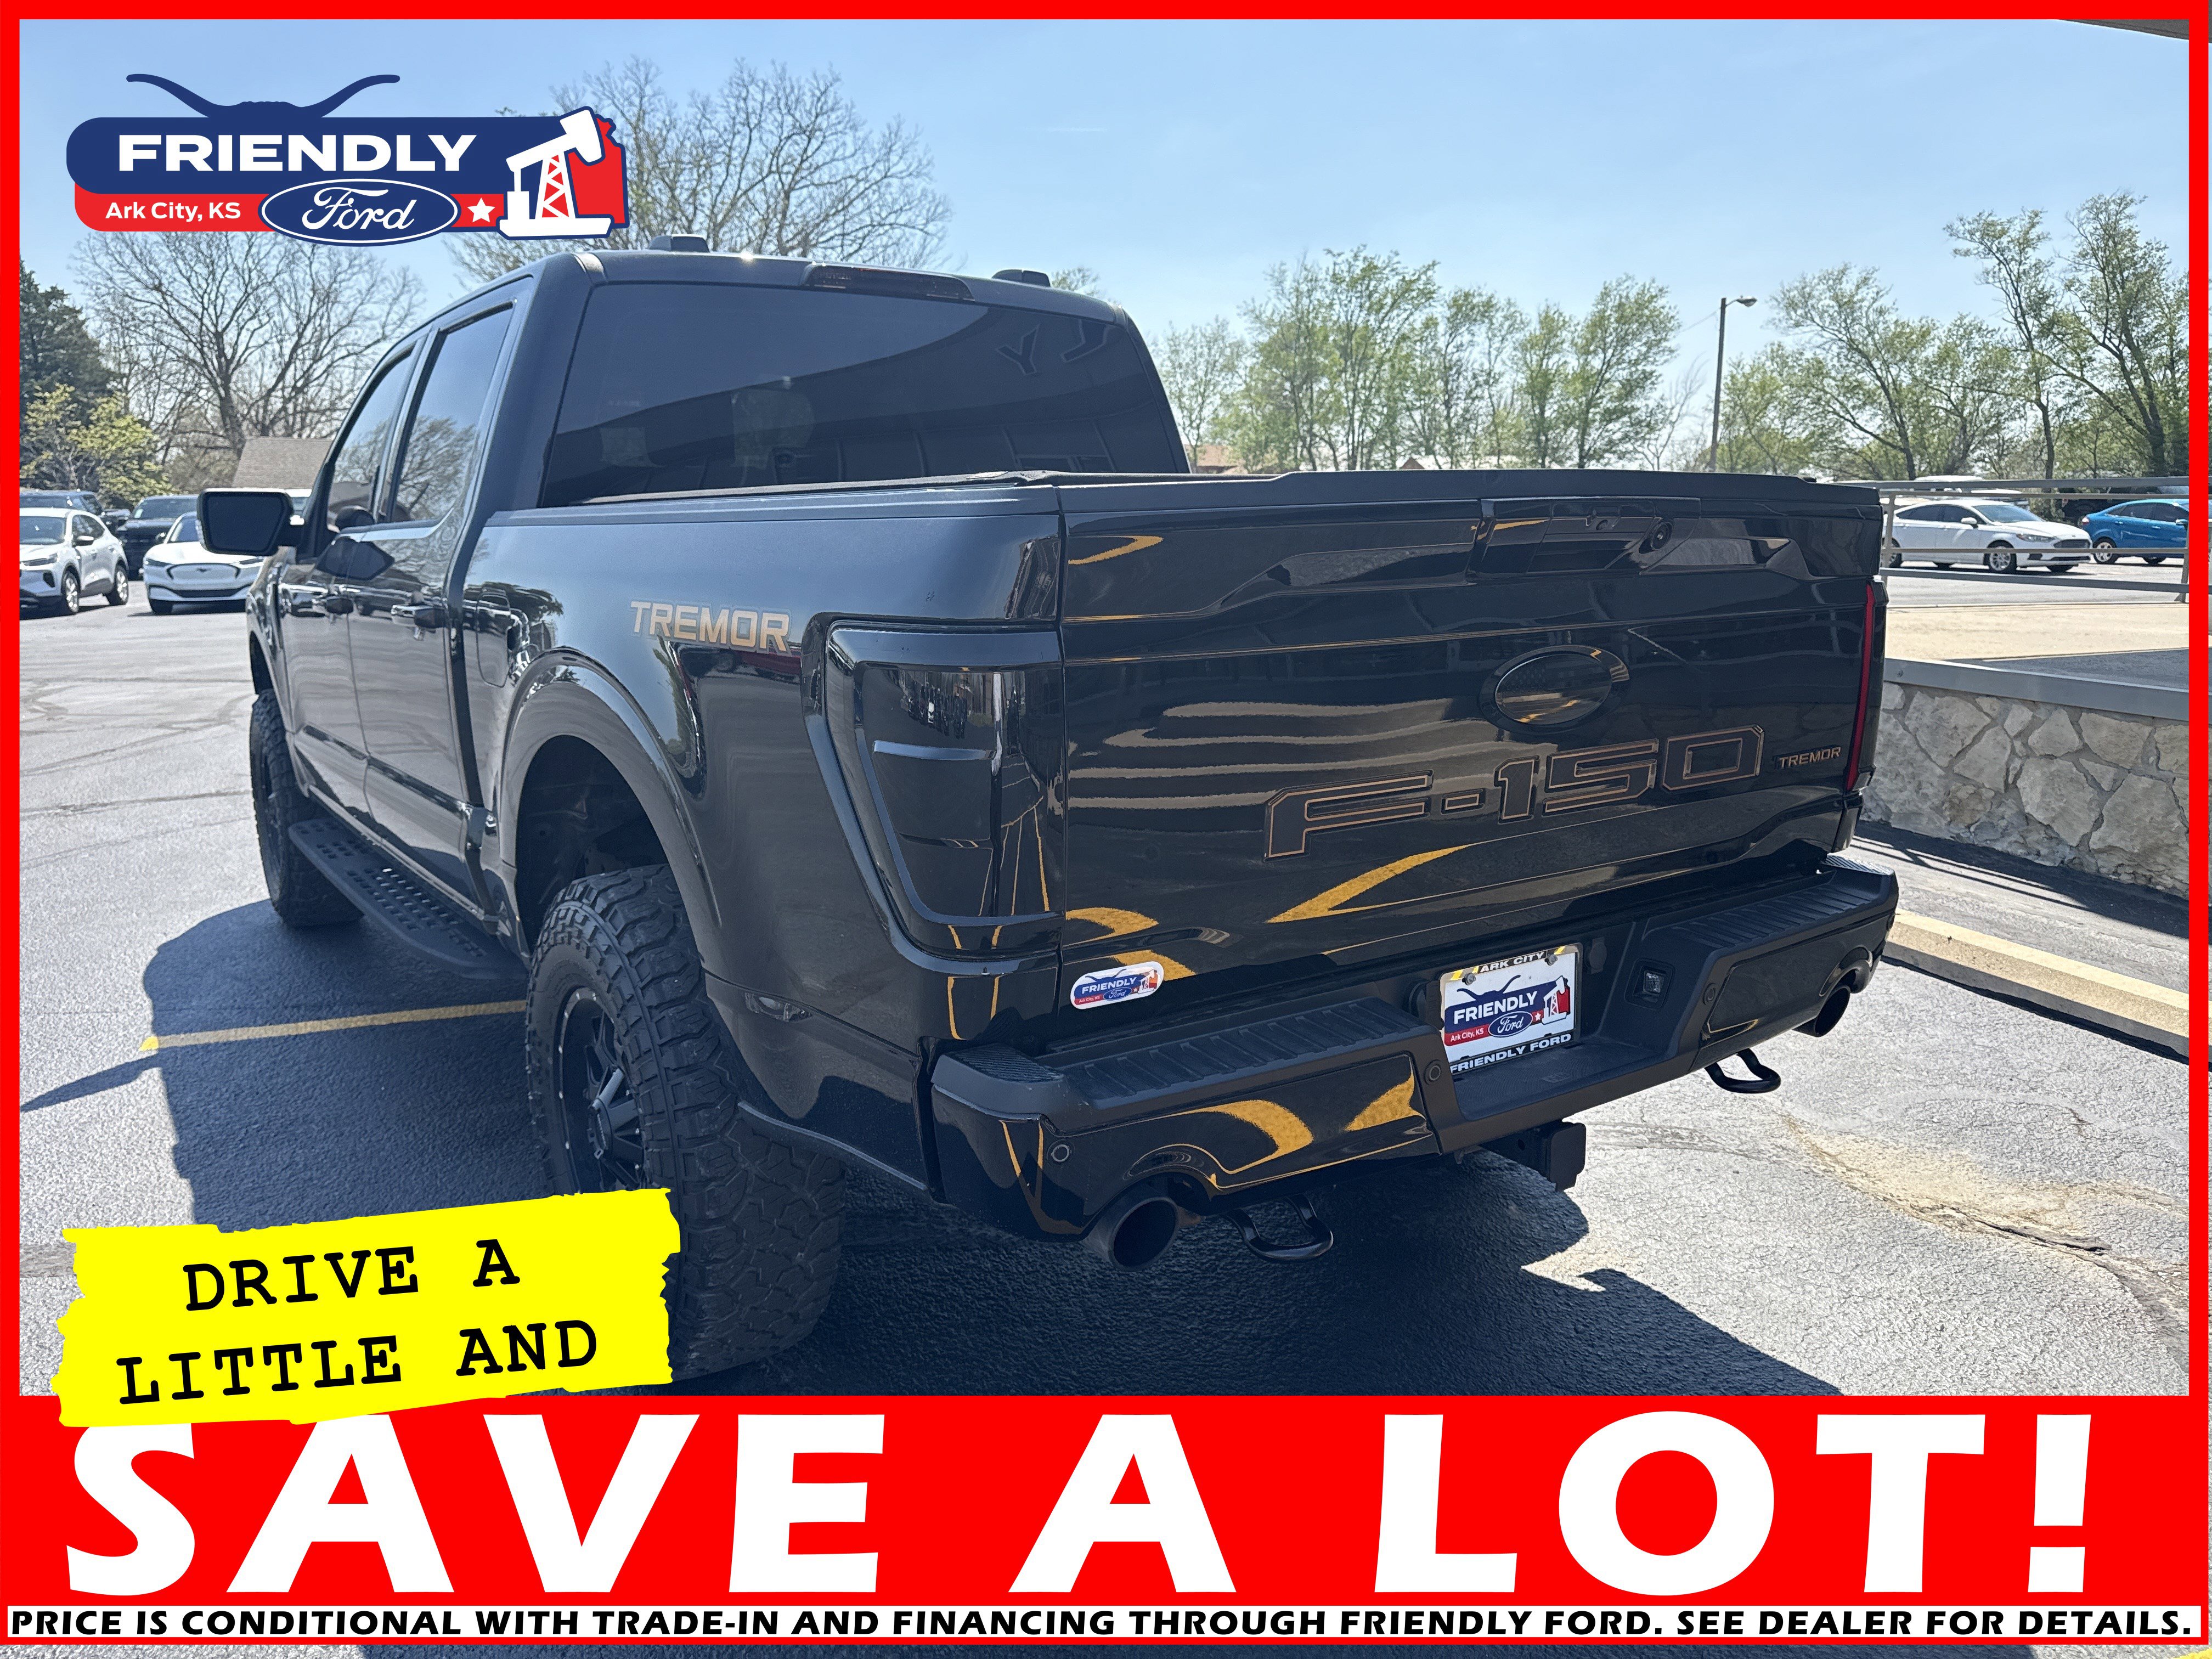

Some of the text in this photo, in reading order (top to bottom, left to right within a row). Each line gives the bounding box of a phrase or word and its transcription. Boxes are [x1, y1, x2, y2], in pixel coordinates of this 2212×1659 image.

[631, 601, 790, 652] TREMOR
[1779, 747, 1841, 768] TREMOR
[1265, 725, 1764, 860] F-150
[1480, 952, 1544, 973] ARK CITY
[1082, 978, 1136, 994] FRIENDLY
[1109, 989, 1126, 998] Ford
[1454, 991, 1538, 1024] FRIENDLY
[1497, 1014, 1523, 1034] Ford
[1450, 1028, 1484, 1042] Ark City, KS
[1450, 1033, 1571, 1073] FRIENDLY FORD
